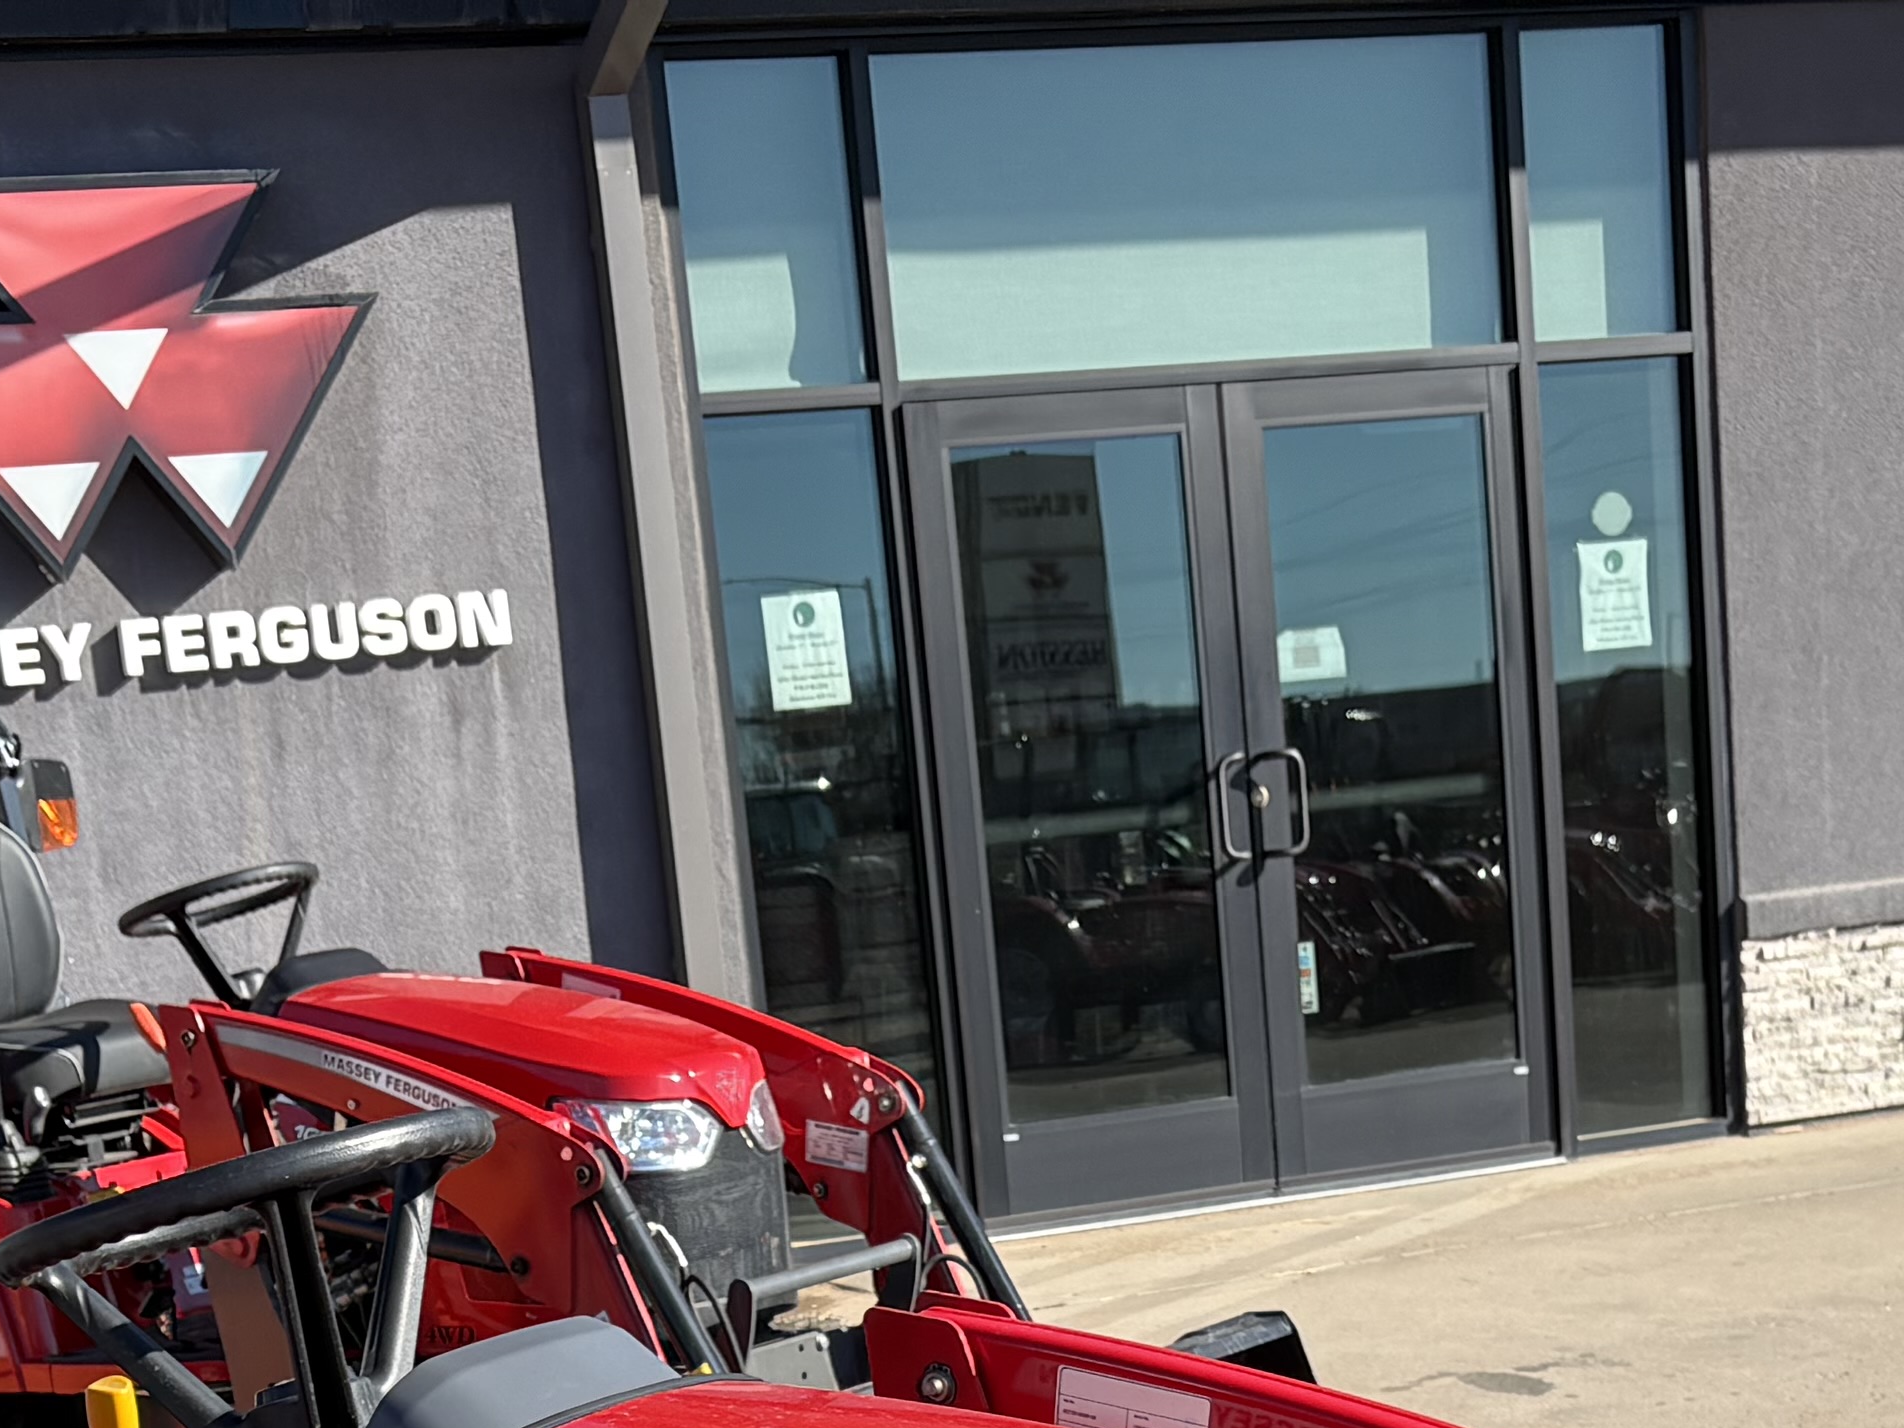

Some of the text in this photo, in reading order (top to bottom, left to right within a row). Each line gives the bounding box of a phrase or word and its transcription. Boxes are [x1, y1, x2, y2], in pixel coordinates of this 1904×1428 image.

[121, 590, 512, 679] FERGUSON
[322, 1054, 459, 1110] MASSEY FERGUSO
[427, 1325, 476, 1345] 4WD
